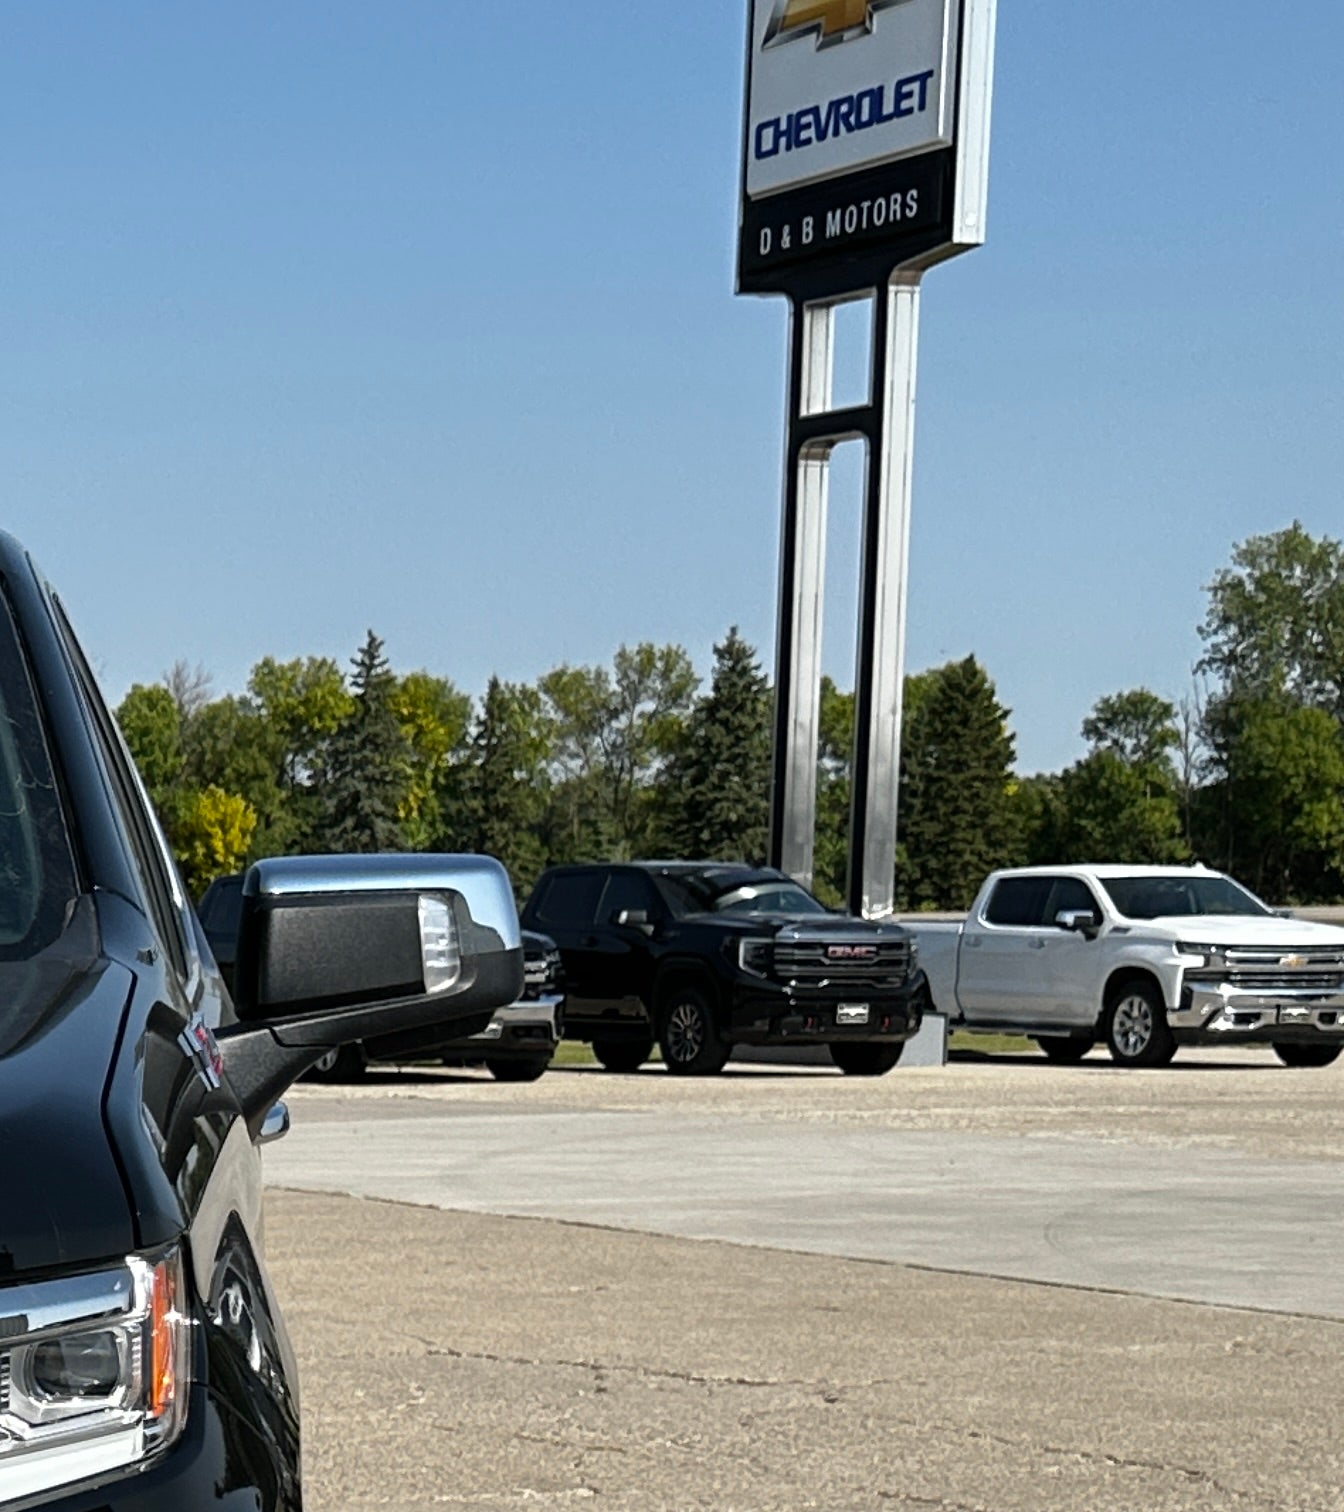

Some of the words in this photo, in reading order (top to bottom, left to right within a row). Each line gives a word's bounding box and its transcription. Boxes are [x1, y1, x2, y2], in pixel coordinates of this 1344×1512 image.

[754, 69, 934, 161] CHEVROLET
[759, 226, 772, 256] D
[780, 224, 791, 249] &
[801, 216, 814, 245] B
[825, 189, 919, 239] MOTORS
